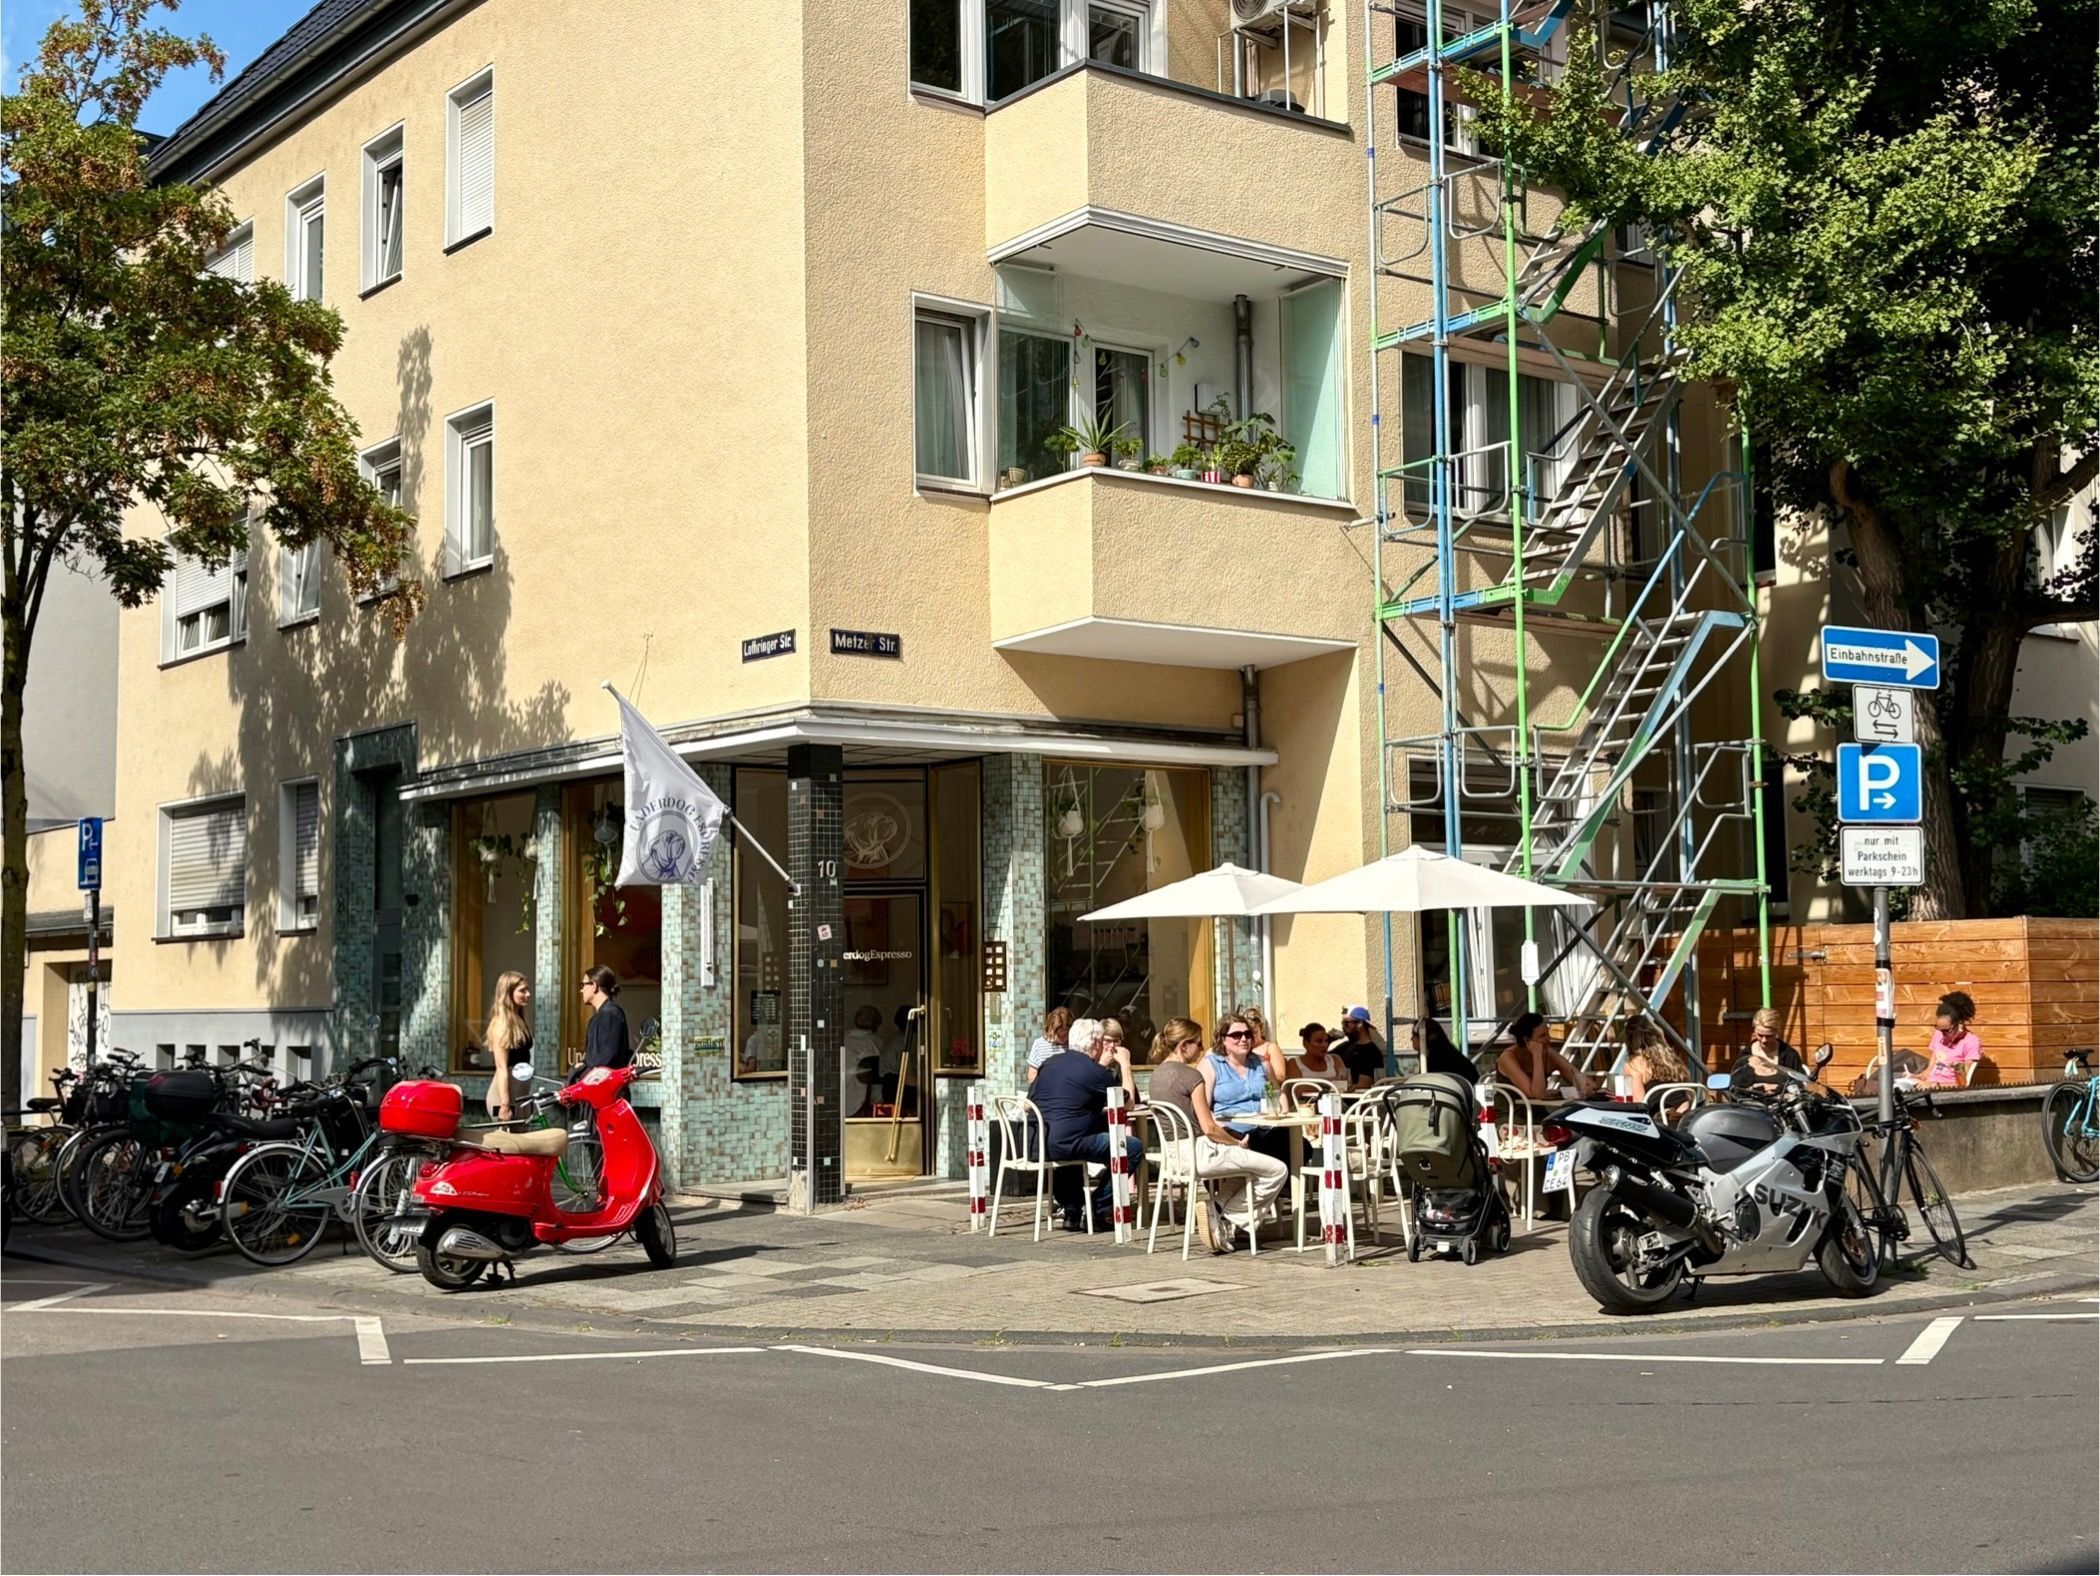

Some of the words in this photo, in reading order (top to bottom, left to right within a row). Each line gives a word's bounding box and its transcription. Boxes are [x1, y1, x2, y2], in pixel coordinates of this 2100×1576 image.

[879, 636, 897, 652] Str.
[1830, 647, 1909, 665] Einbahnstraße
[1858, 754, 1901, 812] P
[1864, 837, 1880, 846] nur
[1884, 836, 1899, 846] mit
[1857, 850, 1907, 862] Parkschein
[817, 859, 837, 878] 10
[1847, 866, 1888, 879] werktags
